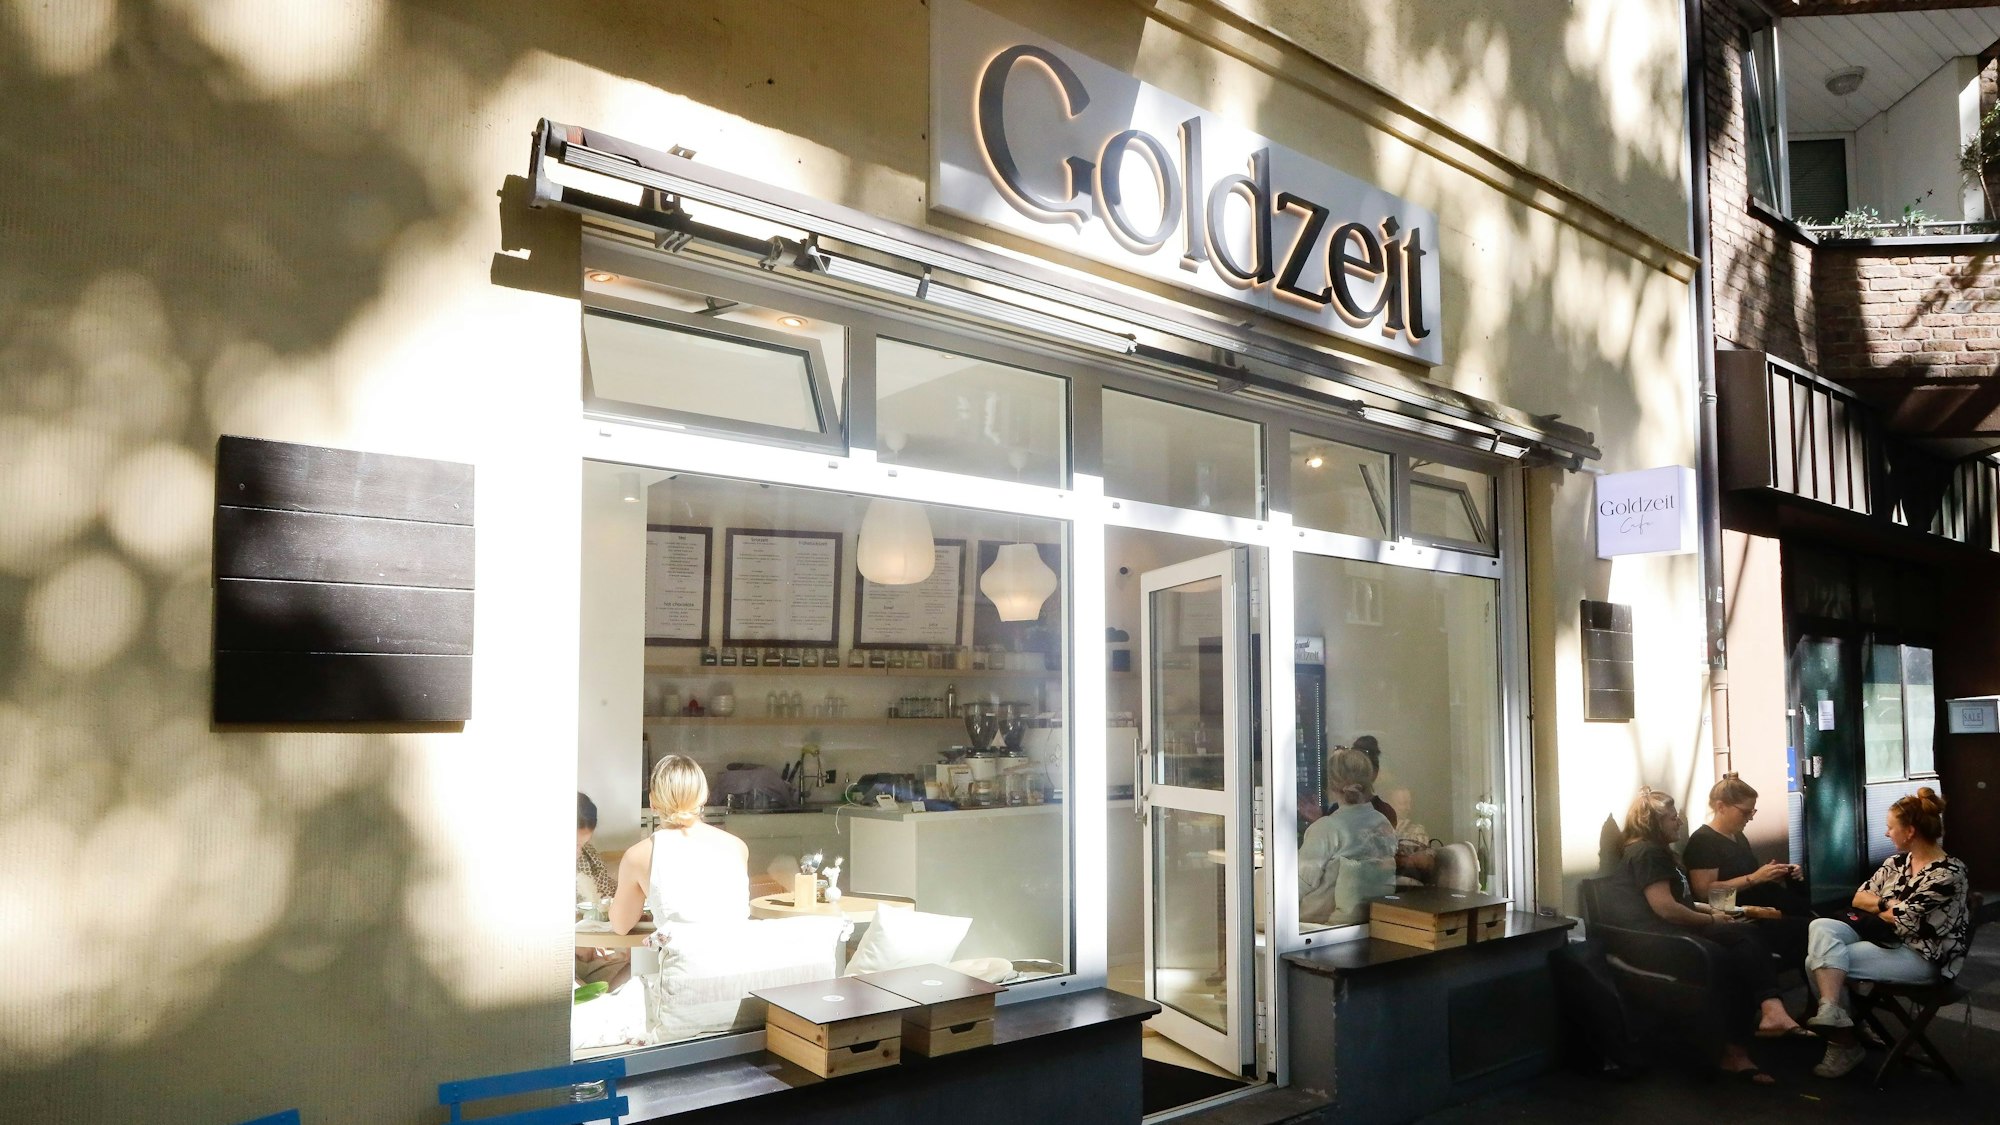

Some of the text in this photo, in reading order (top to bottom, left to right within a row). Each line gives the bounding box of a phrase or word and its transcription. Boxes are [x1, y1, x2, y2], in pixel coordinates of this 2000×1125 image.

[976, 44, 1431, 342] Goldzeit
[1600, 495, 1674, 516] Goldzeit
[1963, 712, 1981, 721] SALE
